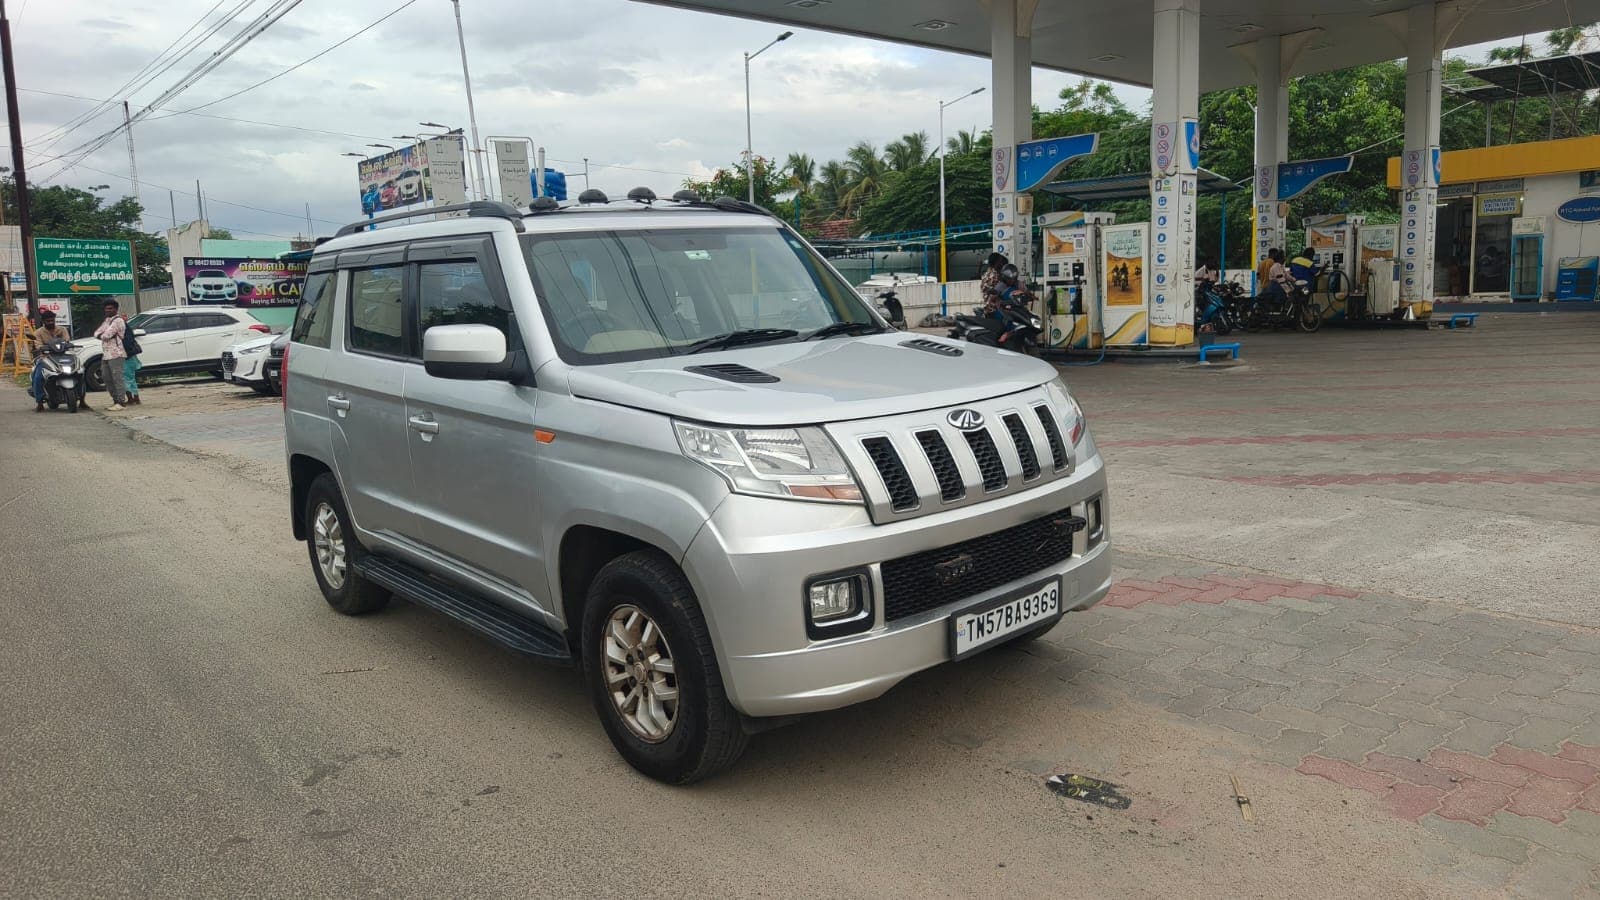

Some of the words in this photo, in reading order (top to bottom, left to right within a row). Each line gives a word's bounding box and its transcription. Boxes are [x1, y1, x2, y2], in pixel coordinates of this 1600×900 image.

[40, 269, 134, 283] அறிவுத்திருக்கோயில்
[255, 282, 276, 296] SM
[967, 588, 1057, 642] TN57BA9369
